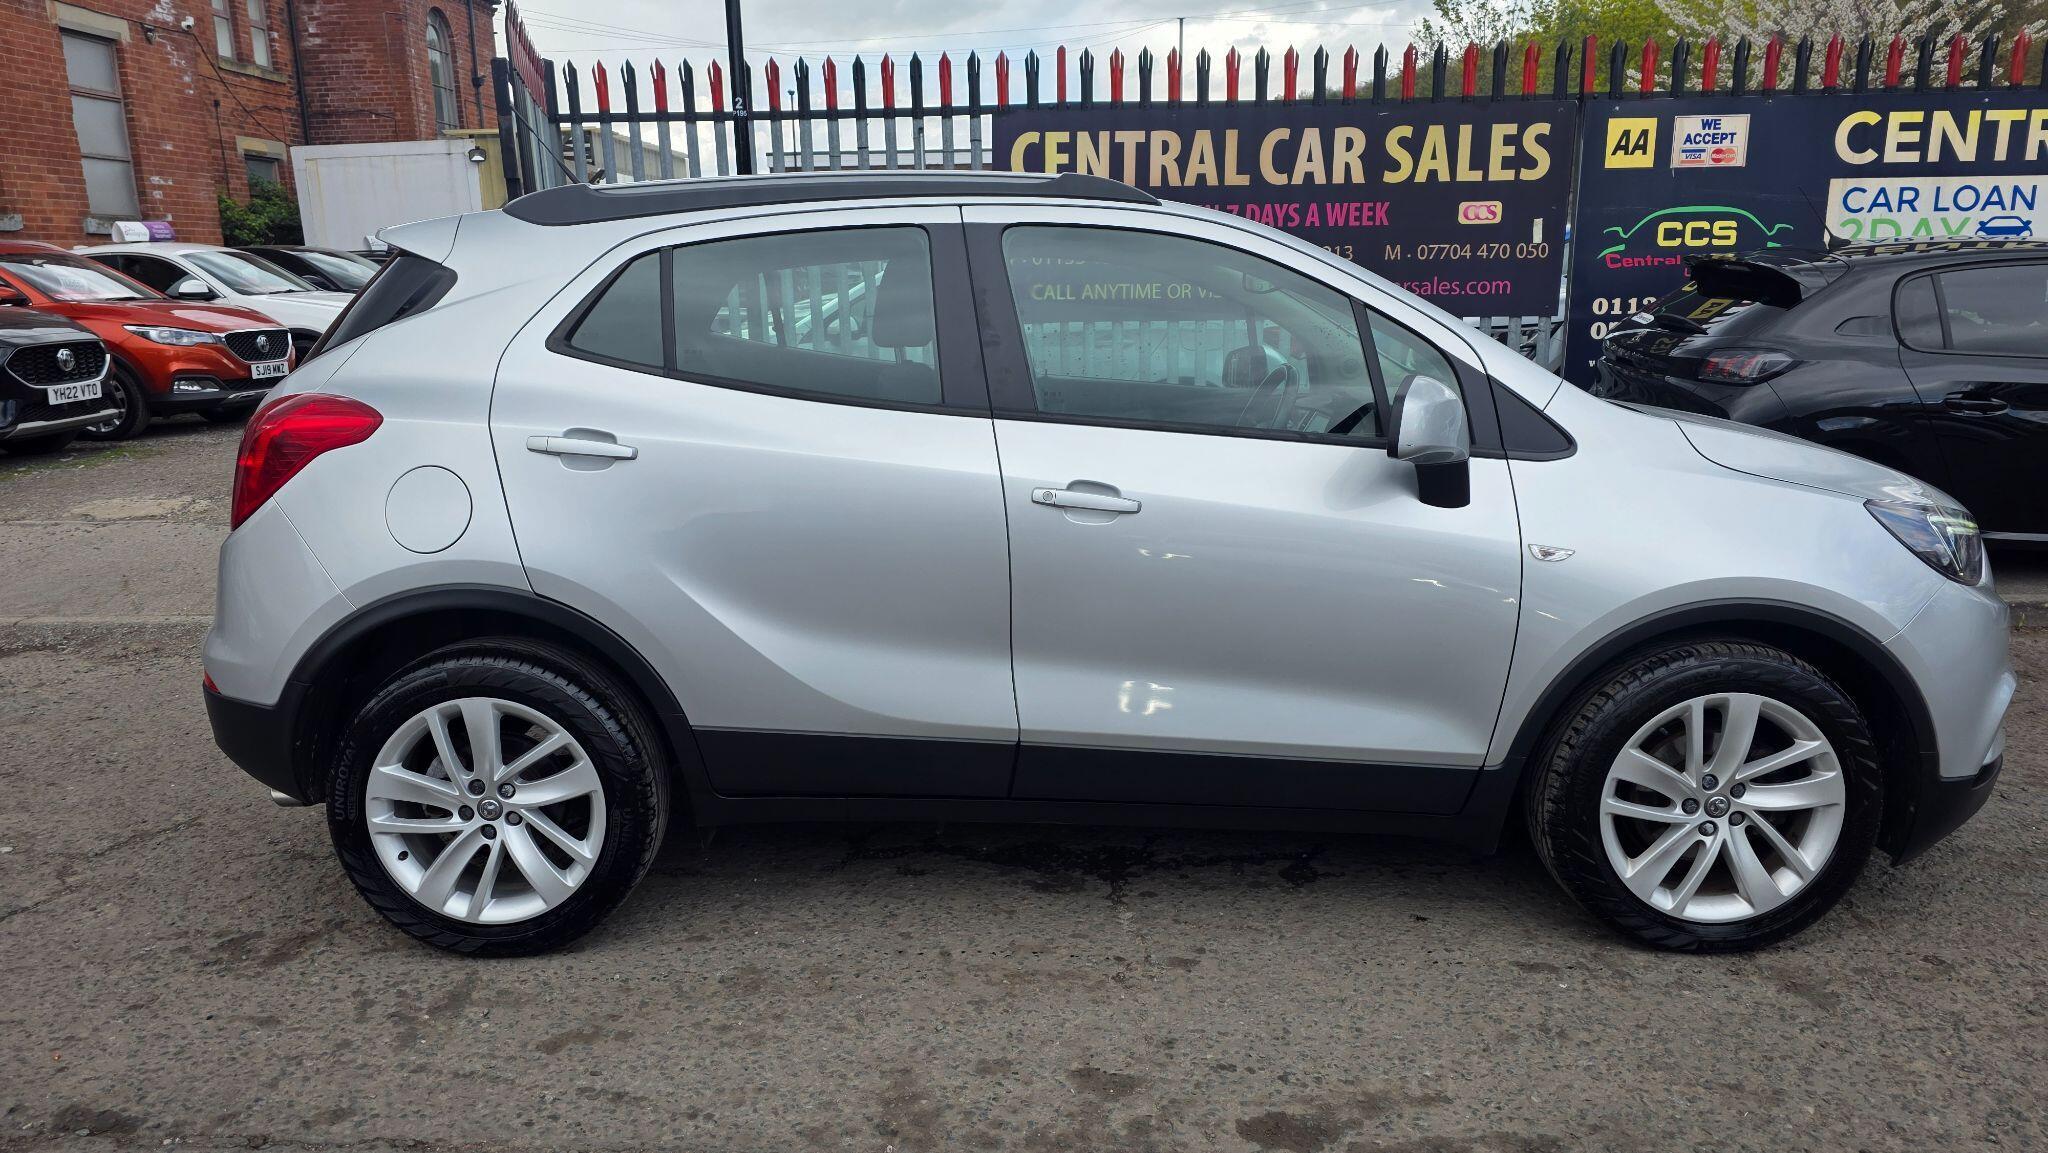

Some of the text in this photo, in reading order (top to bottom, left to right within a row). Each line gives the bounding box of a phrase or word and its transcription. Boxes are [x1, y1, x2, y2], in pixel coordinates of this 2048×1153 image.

[734, 96, 743, 109] 2
[1700, 118, 1722, 131] WE
[1611, 128, 1650, 156] AA
[1682, 132, 1737, 146] ACCEPT
[1010, 122, 1552, 187] CENTRAL CAR SALES
[1842, 184, 2038, 214] CAR LOAN
[1245, 203, 1300, 227] DAYS
[1305, 203, 1320, 227] A
[1326, 201, 1390, 227] WEEK
[1463, 204, 1498, 221] CCS
[1656, 220, 1738, 247] CCS
[1839, 216, 1972, 241] 2DAY
[1384, 245, 1401, 261] M
[1417, 244, 1472, 260] 07704
[1476, 243, 1511, 259] 470
[1515, 242, 1549, 259] 050
[1605, 253, 1681, 269] Central
[1031, 284, 1076, 300] CALL
[1081, 283, 1162, 300] ANYTIME
[1167, 283, 1192, 299] OR
[255, 366, 272, 376] SJ19
[53, 383, 98, 401] YH22 VTO
